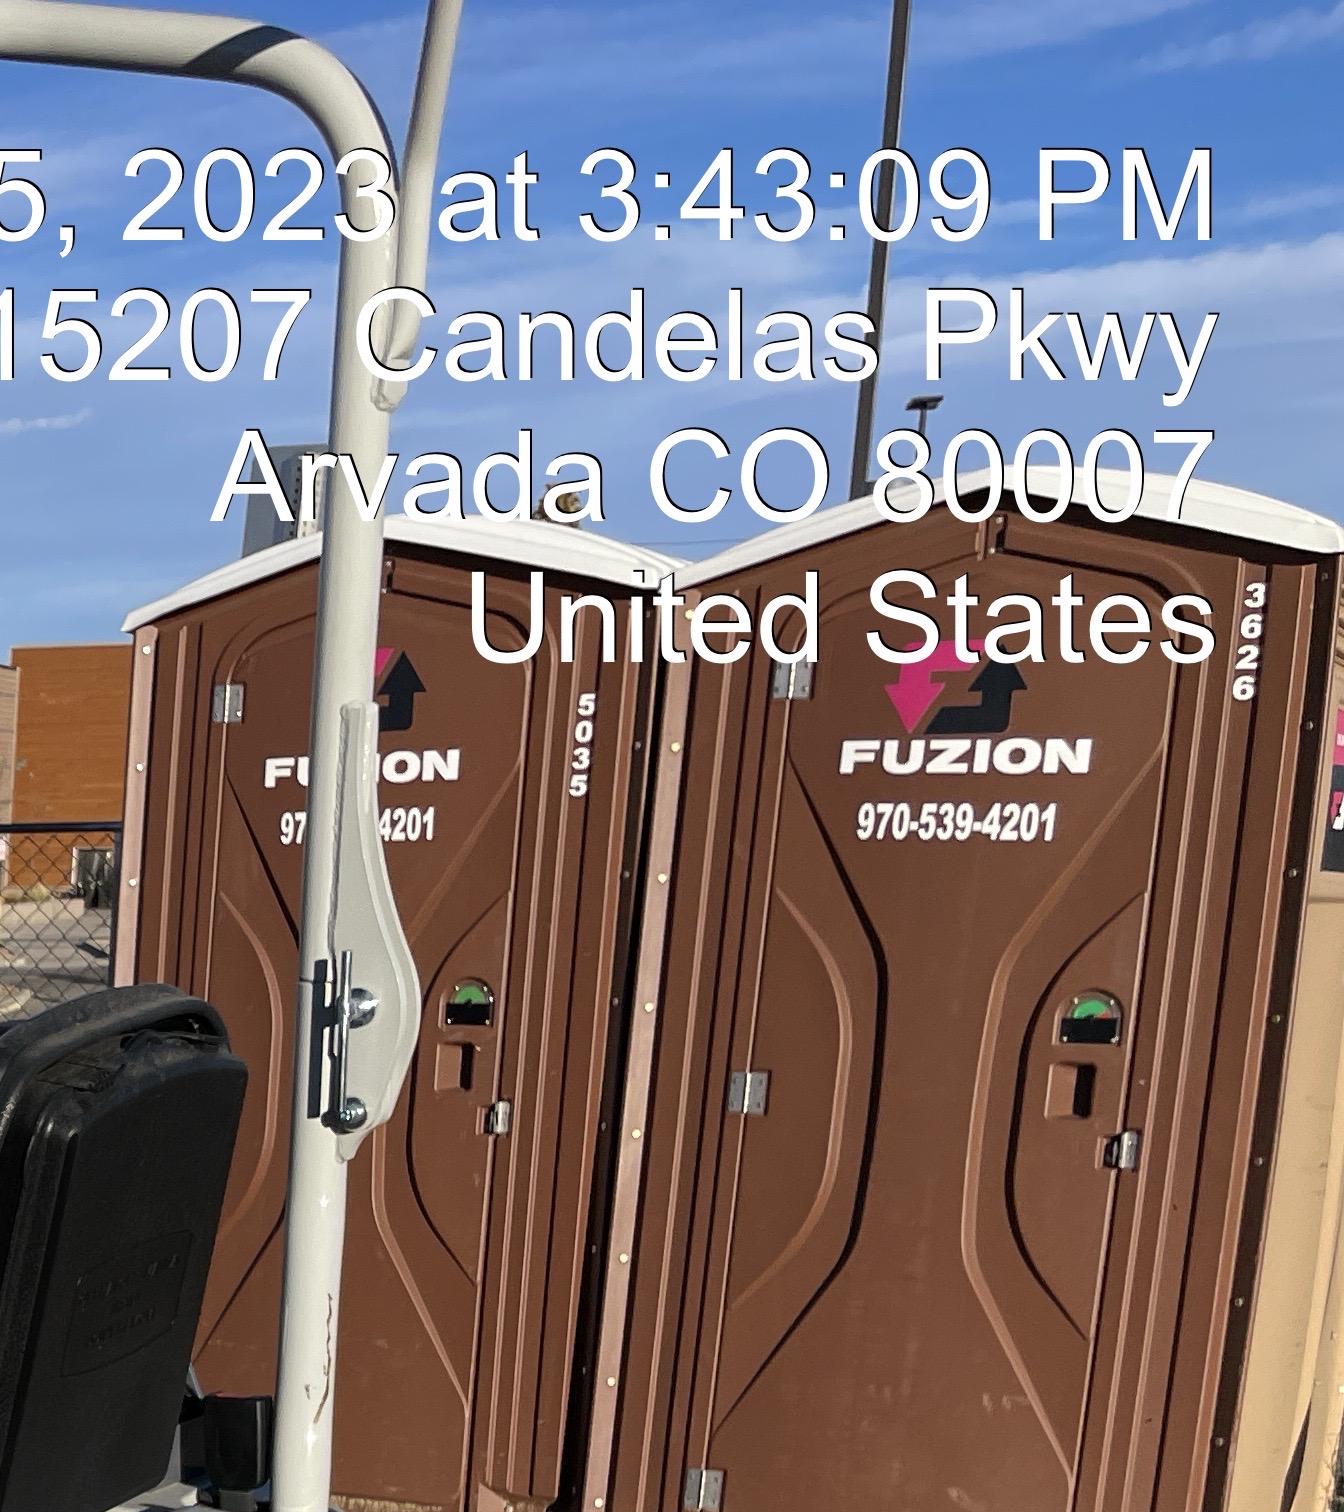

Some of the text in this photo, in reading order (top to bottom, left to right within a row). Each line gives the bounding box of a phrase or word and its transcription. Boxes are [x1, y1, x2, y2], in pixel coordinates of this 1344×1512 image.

[1231, 581, 1267, 701] 3626
[568, 692, 597, 798] 5035
[838, 737, 1093, 775] FUZION
[856, 801, 1057, 842] 970-539-4201
